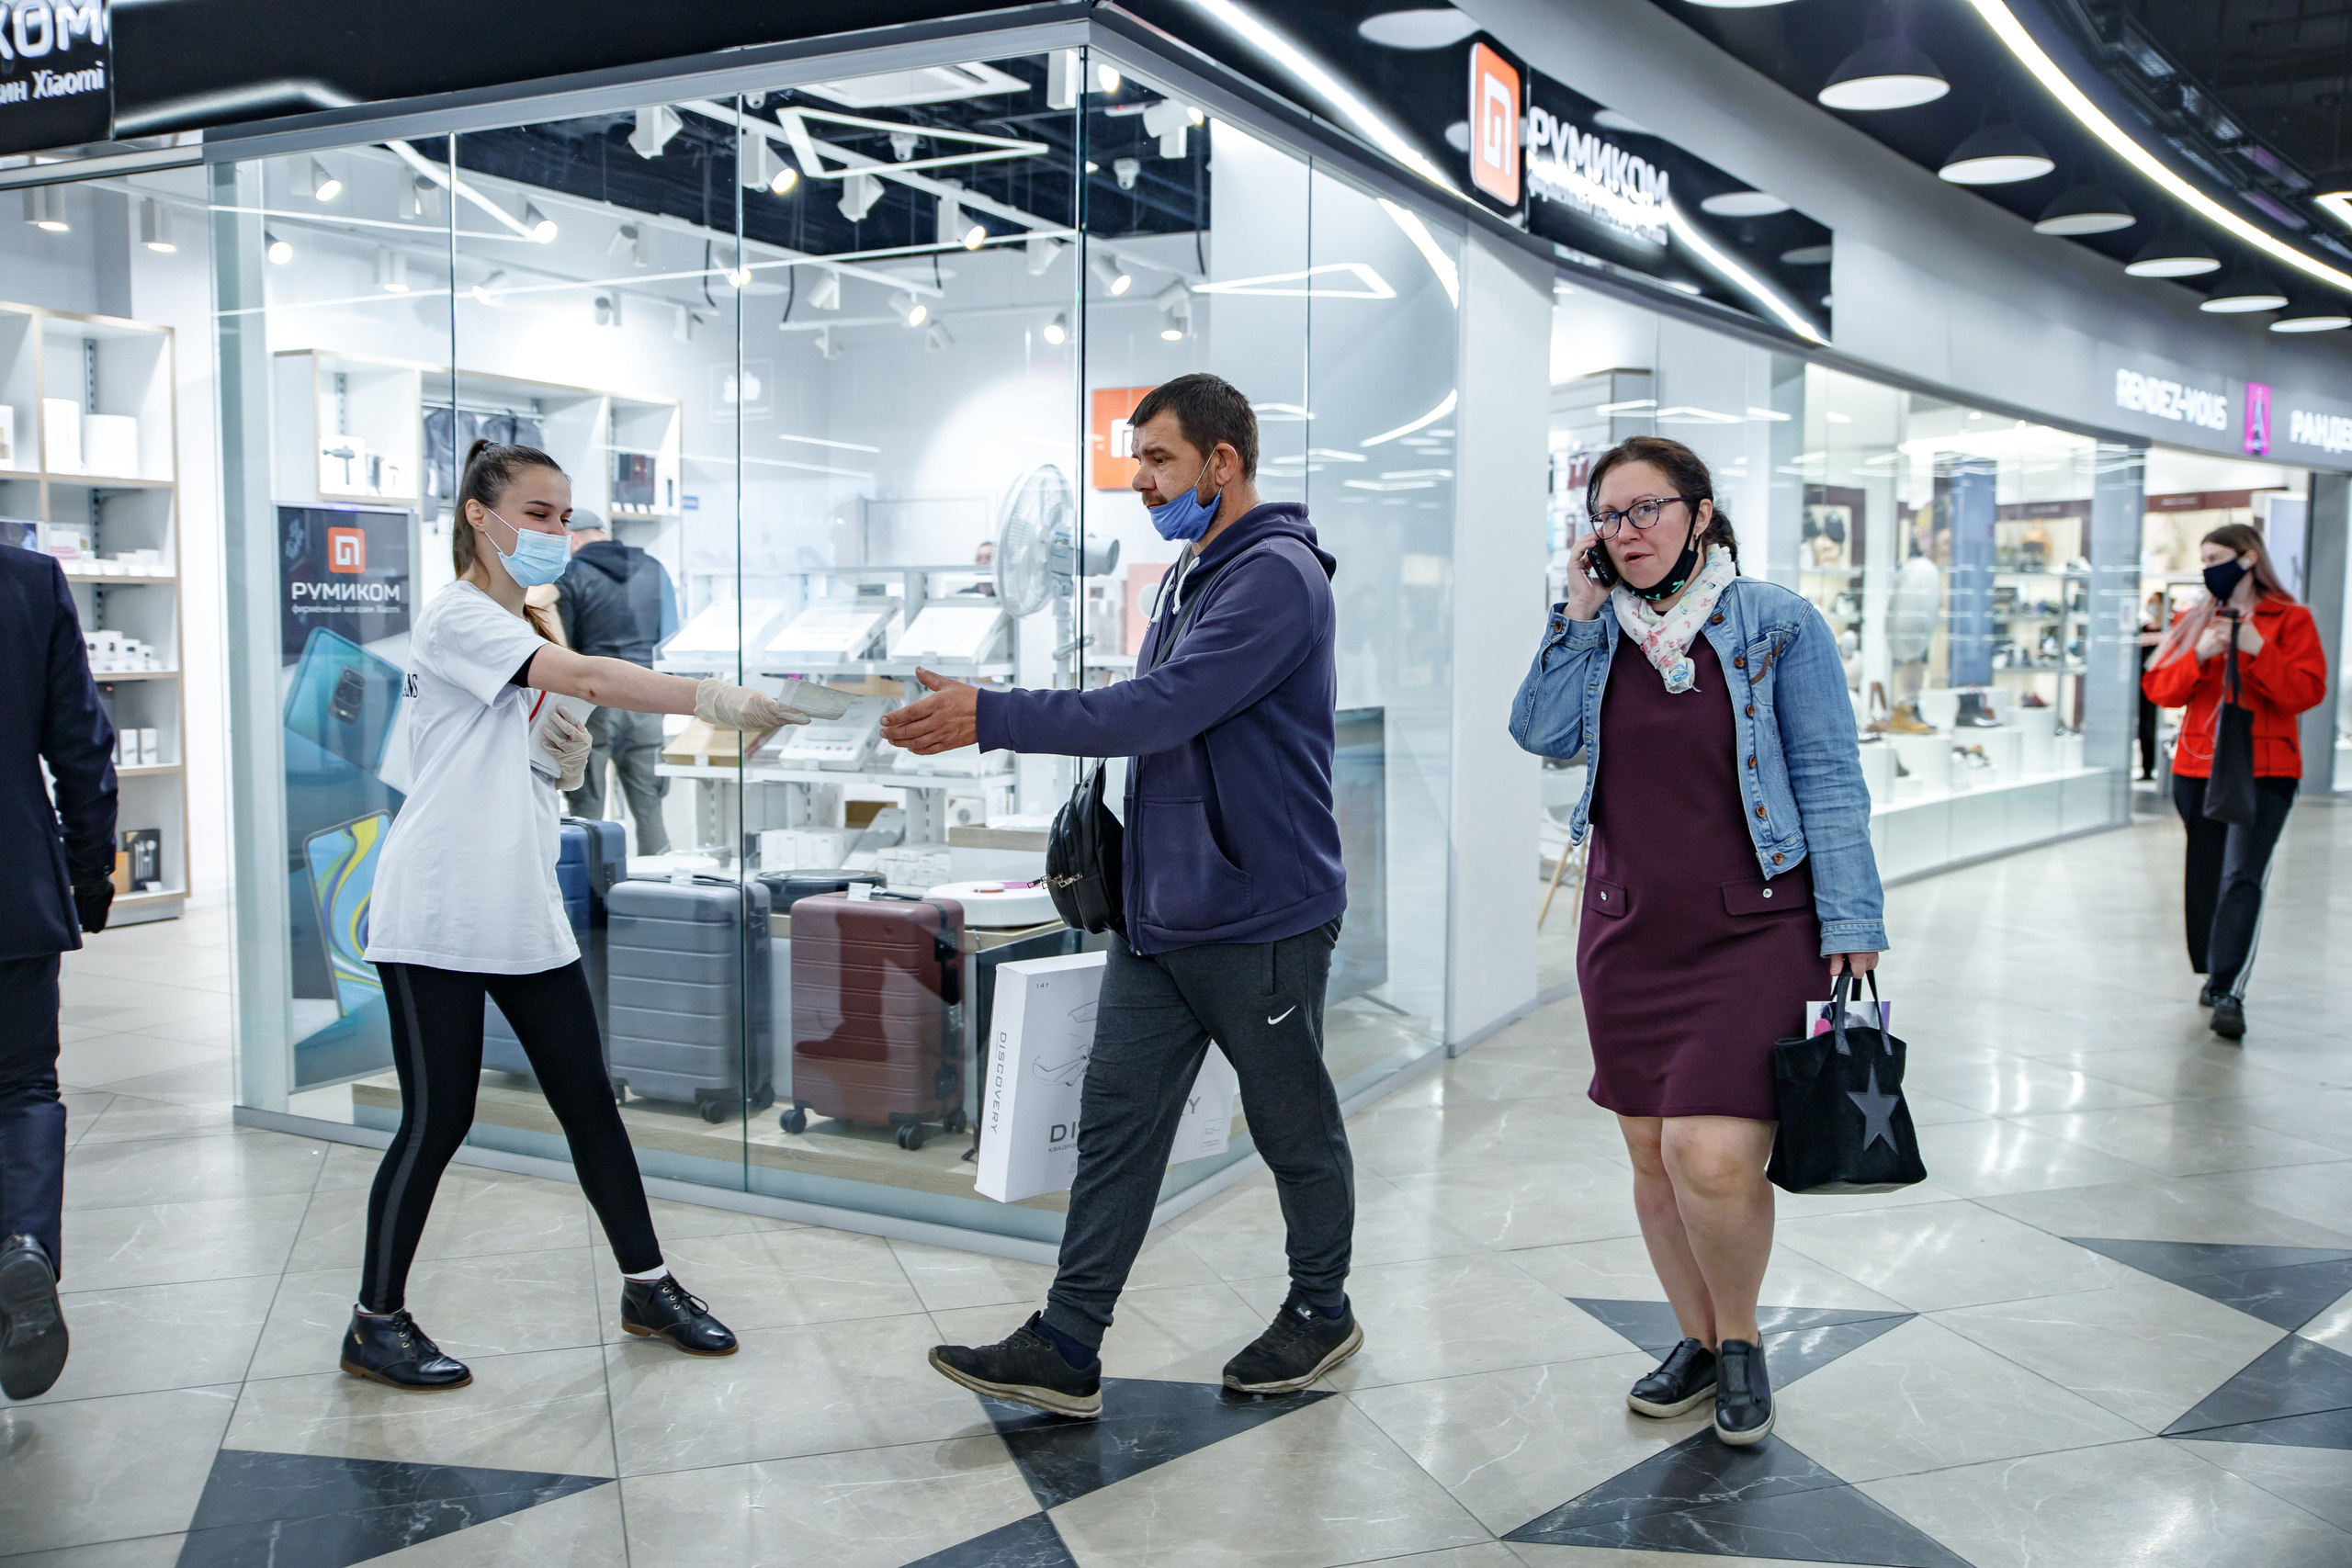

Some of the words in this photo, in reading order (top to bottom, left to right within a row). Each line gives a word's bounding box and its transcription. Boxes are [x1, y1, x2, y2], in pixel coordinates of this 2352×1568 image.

[31, 60, 106, 99] Xiaomi
[1528, 105, 1669, 208] РУМИКОМ
[2116, 367, 2228, 431] RENDEZ-VOUS
[291, 581, 401, 602] РУМИКОМ
[1035, 981, 1050, 989] 14+
[991, 1032, 1008, 1134] DISCOVERY
